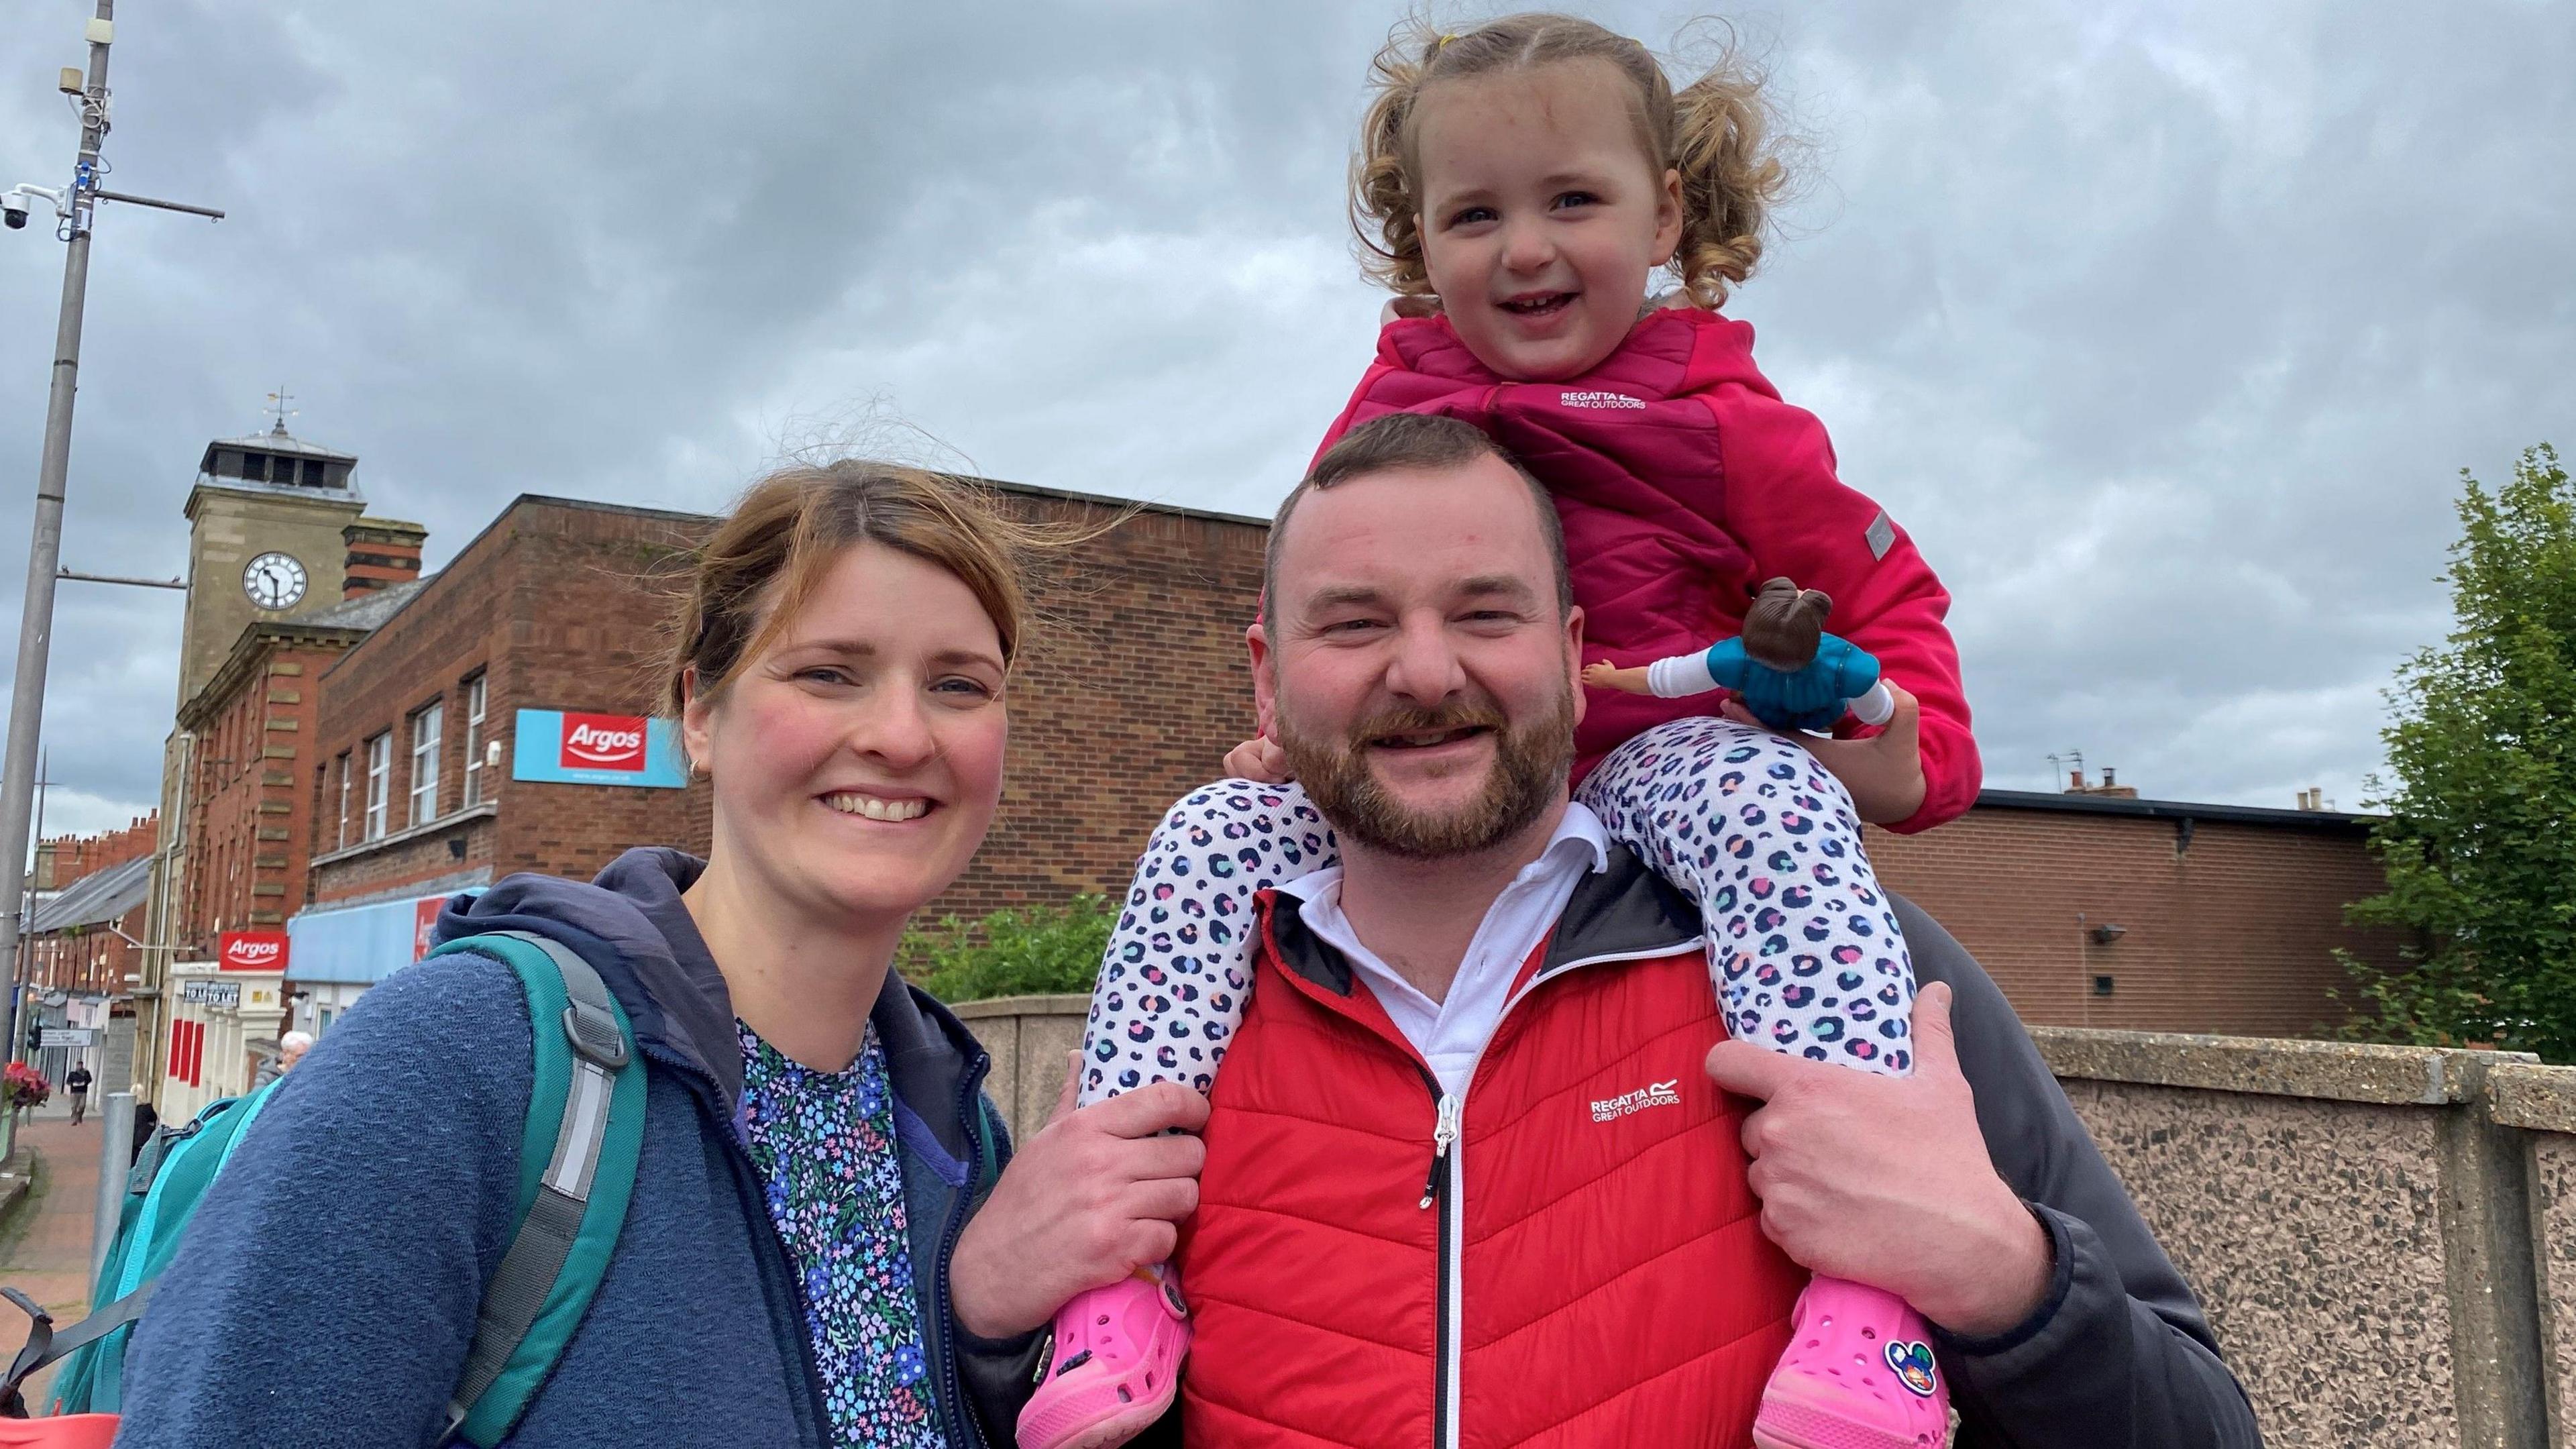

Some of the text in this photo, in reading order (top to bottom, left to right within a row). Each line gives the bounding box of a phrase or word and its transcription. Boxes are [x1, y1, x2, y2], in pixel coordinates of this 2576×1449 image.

[1560, 400, 1646, 409] GREAT OUTDOORS
[1561, 392, 1617, 401] REGATTA
[567, 723, 641, 753] Argos
[228, 938, 279, 959] Argos
[208, 992, 237, 1003] TO LET
[1591, 1089, 1648, 1113] REGATTA
[1593, 1095, 1680, 1122] GREAT OUTDOORS
